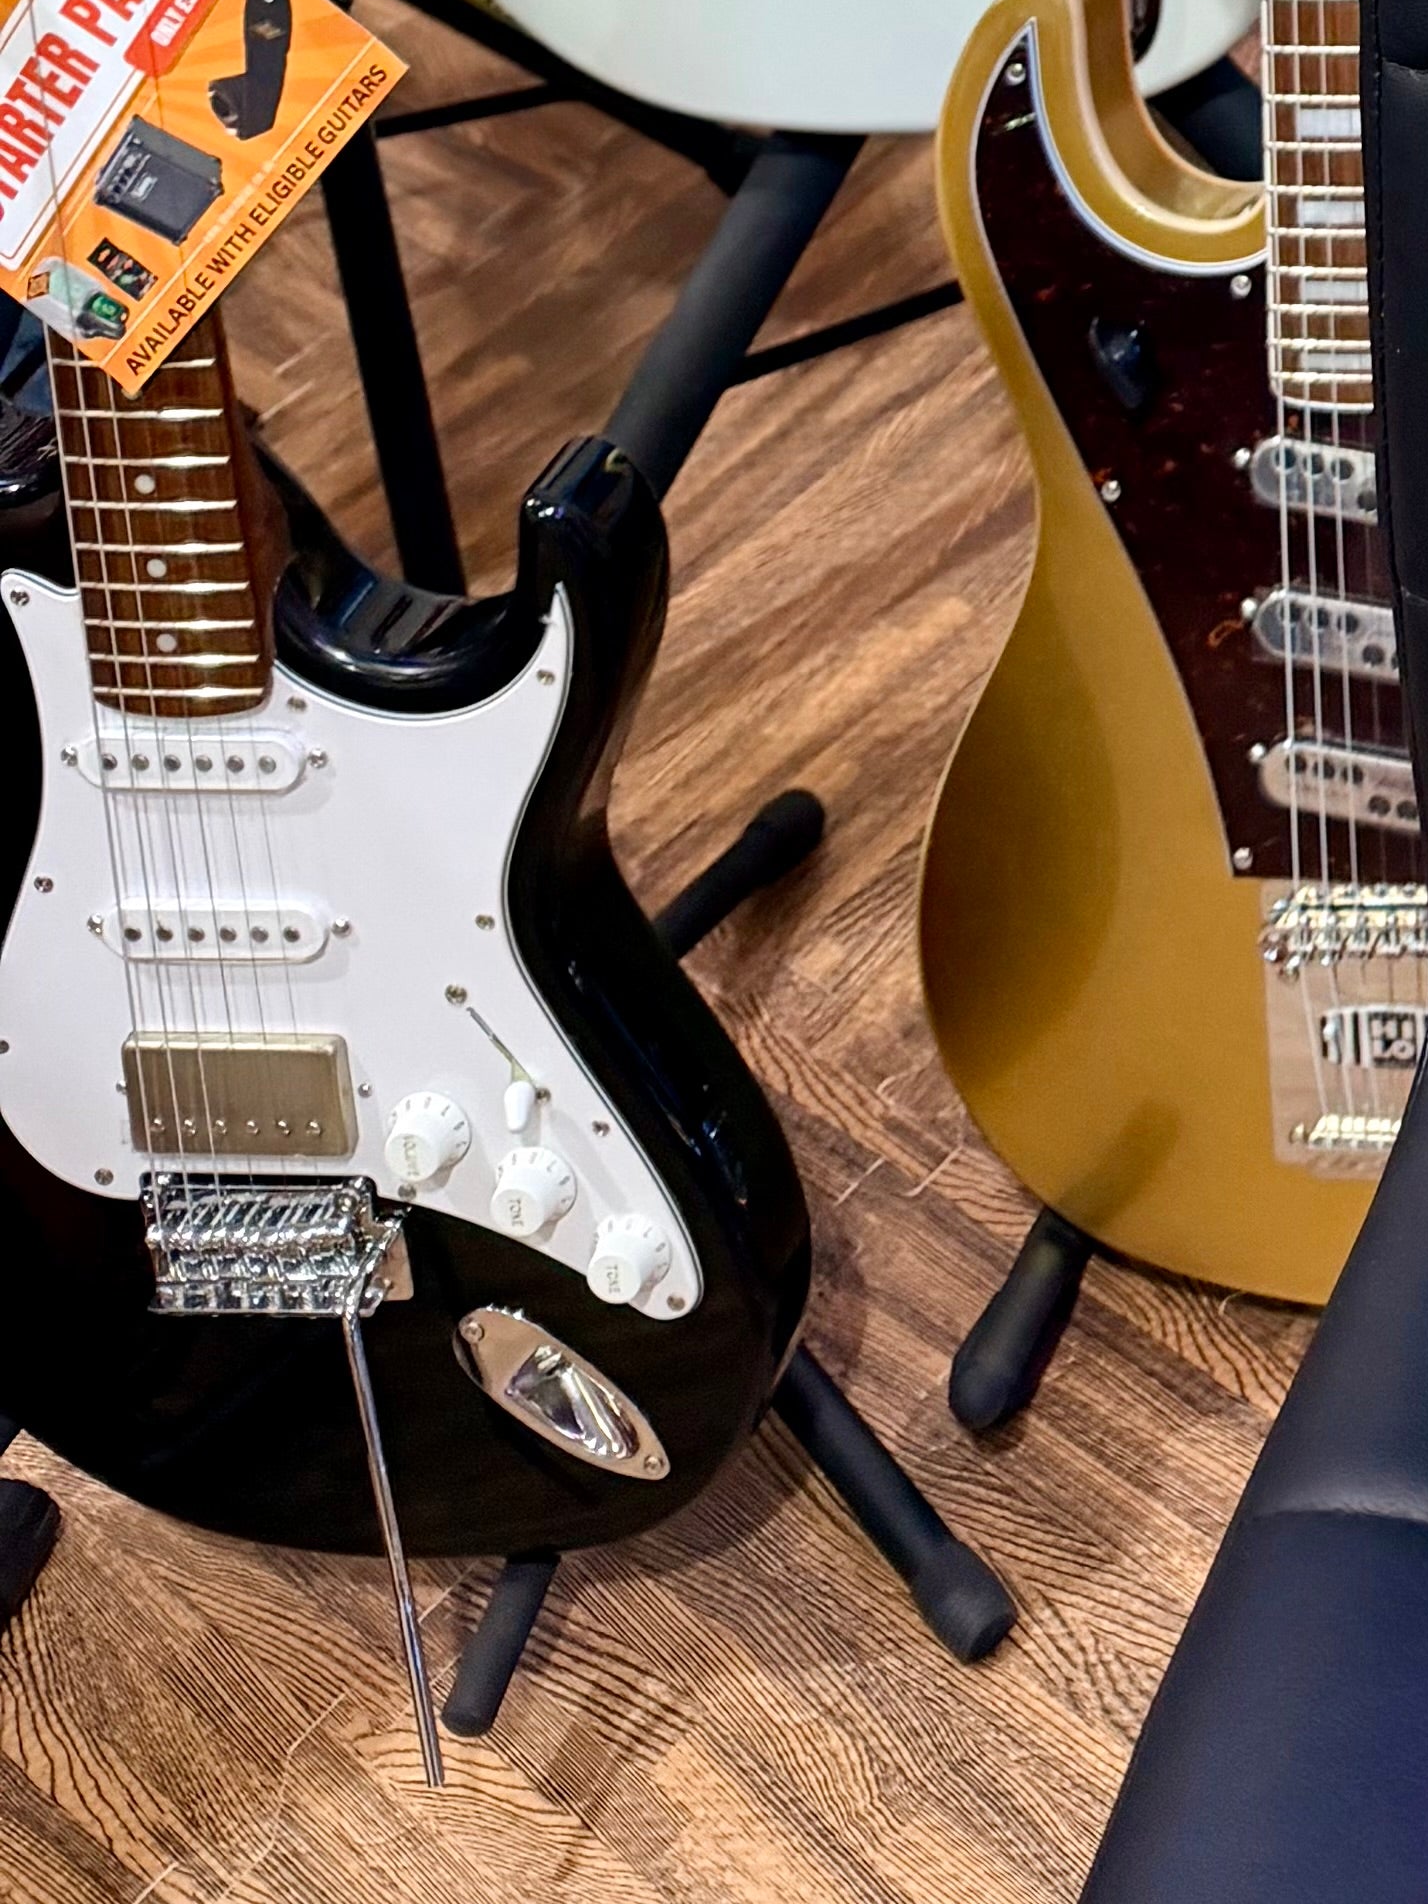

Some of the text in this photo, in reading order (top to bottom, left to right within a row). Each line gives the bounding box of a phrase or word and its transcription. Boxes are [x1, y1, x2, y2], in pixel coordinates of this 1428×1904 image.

[125, 271, 217, 376] AVAILABLE
[210, 222, 255, 280] WITH
[248, 138, 325, 226] ELIGIBLE
[316, 64, 388, 148] GUITARS
